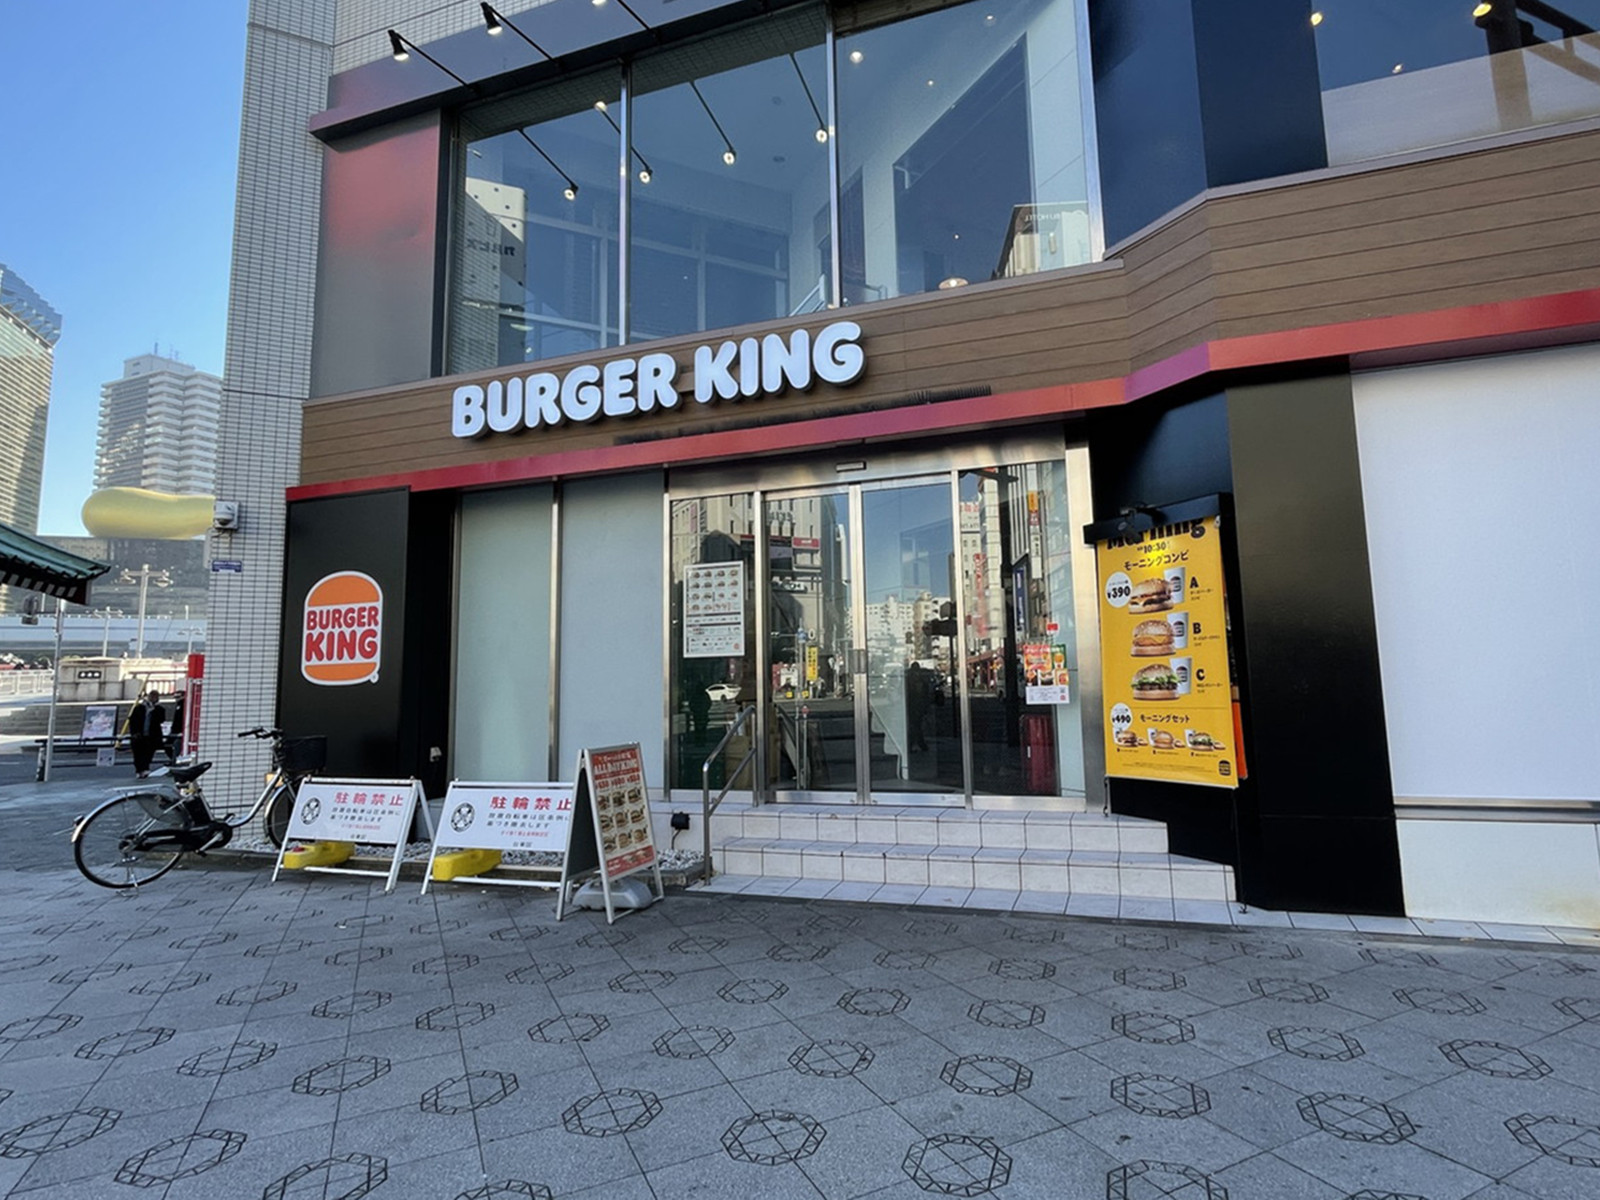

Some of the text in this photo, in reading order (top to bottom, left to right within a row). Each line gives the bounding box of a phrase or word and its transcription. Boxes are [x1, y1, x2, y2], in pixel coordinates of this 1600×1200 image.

[451, 320, 865, 438] BURGER KING
[1190, 576, 1199, 588] A
[1107, 585, 1131, 599] ¥390
[306, 606, 379, 631] BURGER
[1192, 622, 1202, 634] B
[305, 628, 378, 662] KING
[1196, 669, 1205, 681] C
[1140, 714, 1190, 724] モーニングセット
[335, 792, 404, 807] 駐輪禁止
[490, 796, 572, 811] 駐輪禁止
